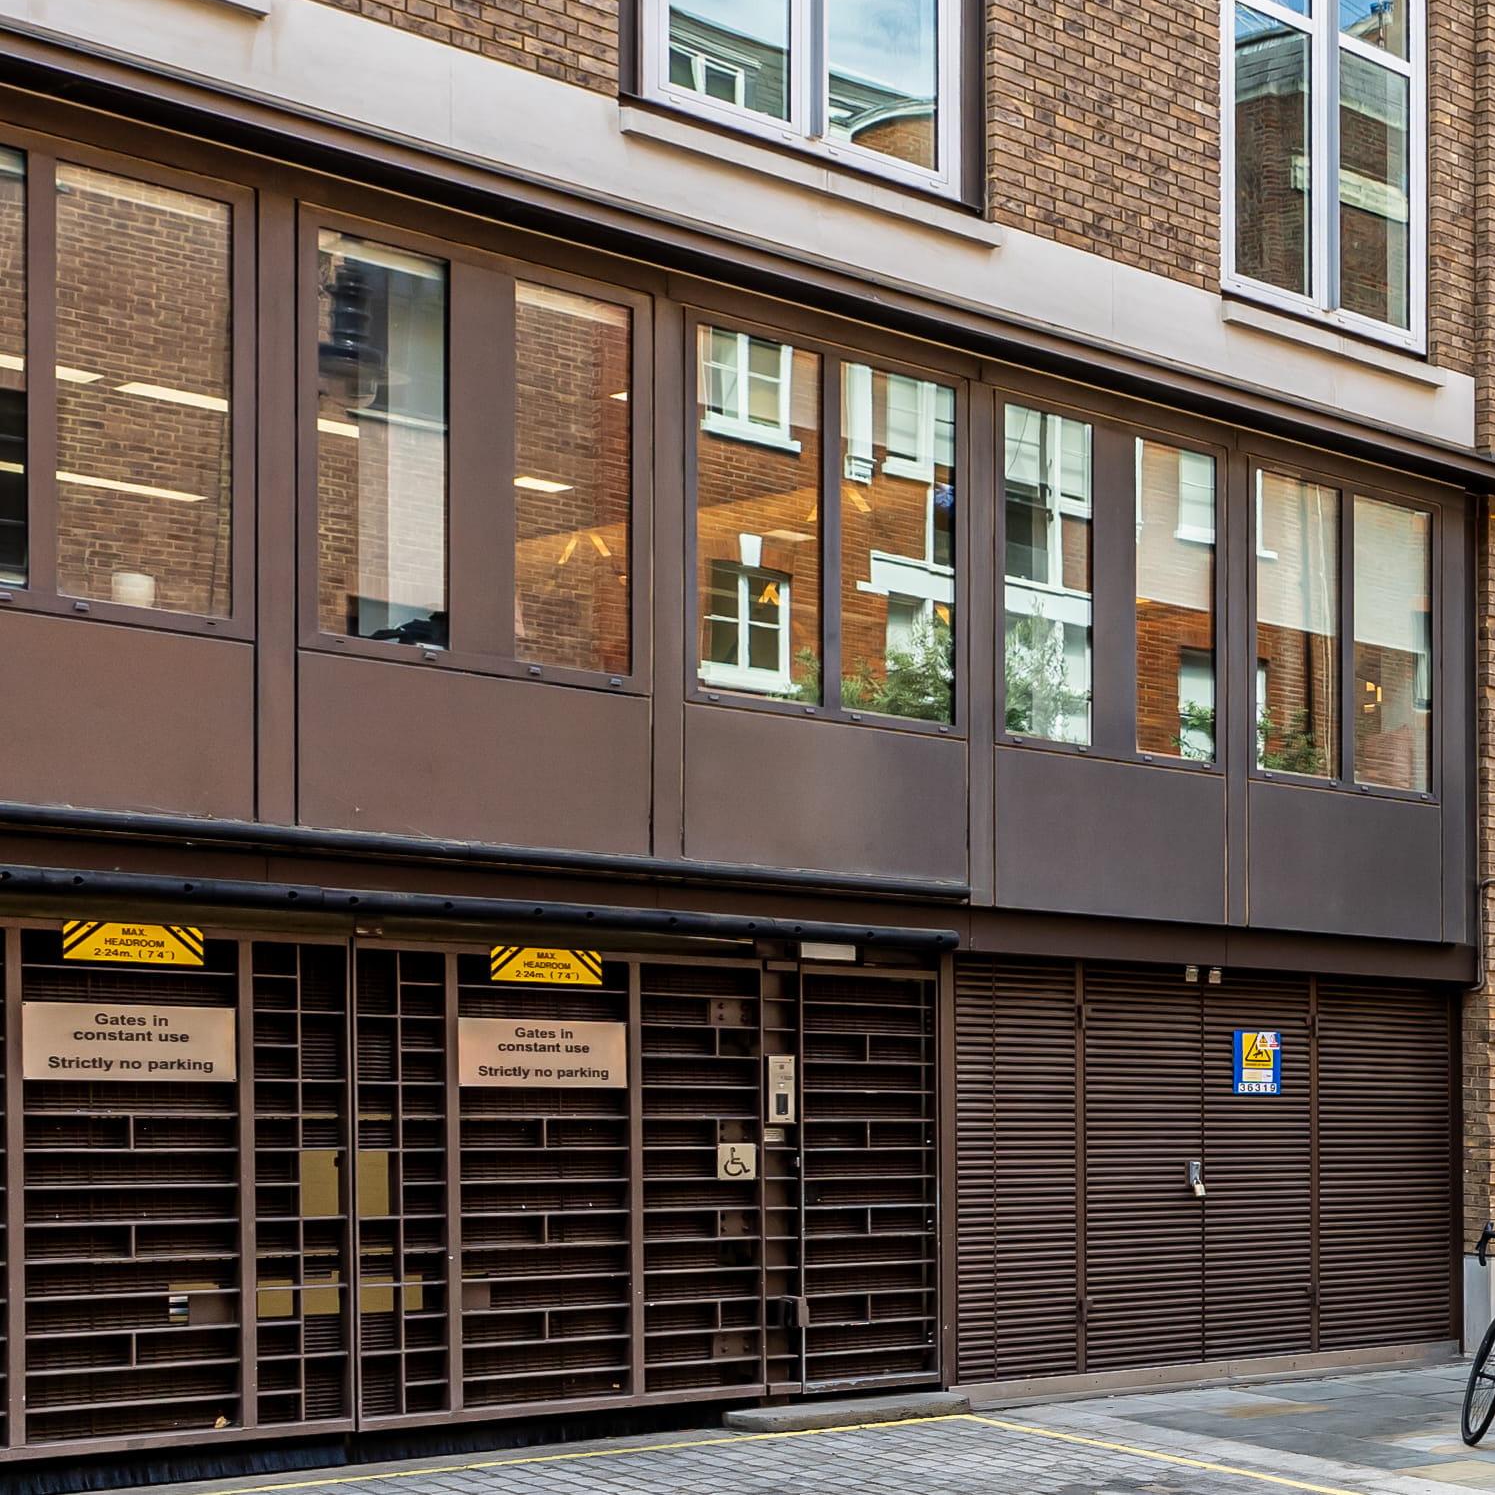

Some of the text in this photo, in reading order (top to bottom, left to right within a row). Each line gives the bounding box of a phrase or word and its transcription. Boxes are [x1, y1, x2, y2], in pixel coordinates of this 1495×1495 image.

[104, 937, 165, 948] HEADROOM
[523, 961, 571, 970] HEADROOM
[94, 1013, 169, 1027] Gates in
[73, 1029, 190, 1043] constant use
[514, 1027, 574, 1039] Gates in
[497, 1042, 590, 1053] constant use
[48, 1056, 214, 1073] Strictly no parking
[478, 1065, 609, 1080] Strictly no parking
[1239, 1083, 1276, 1092] 36319
